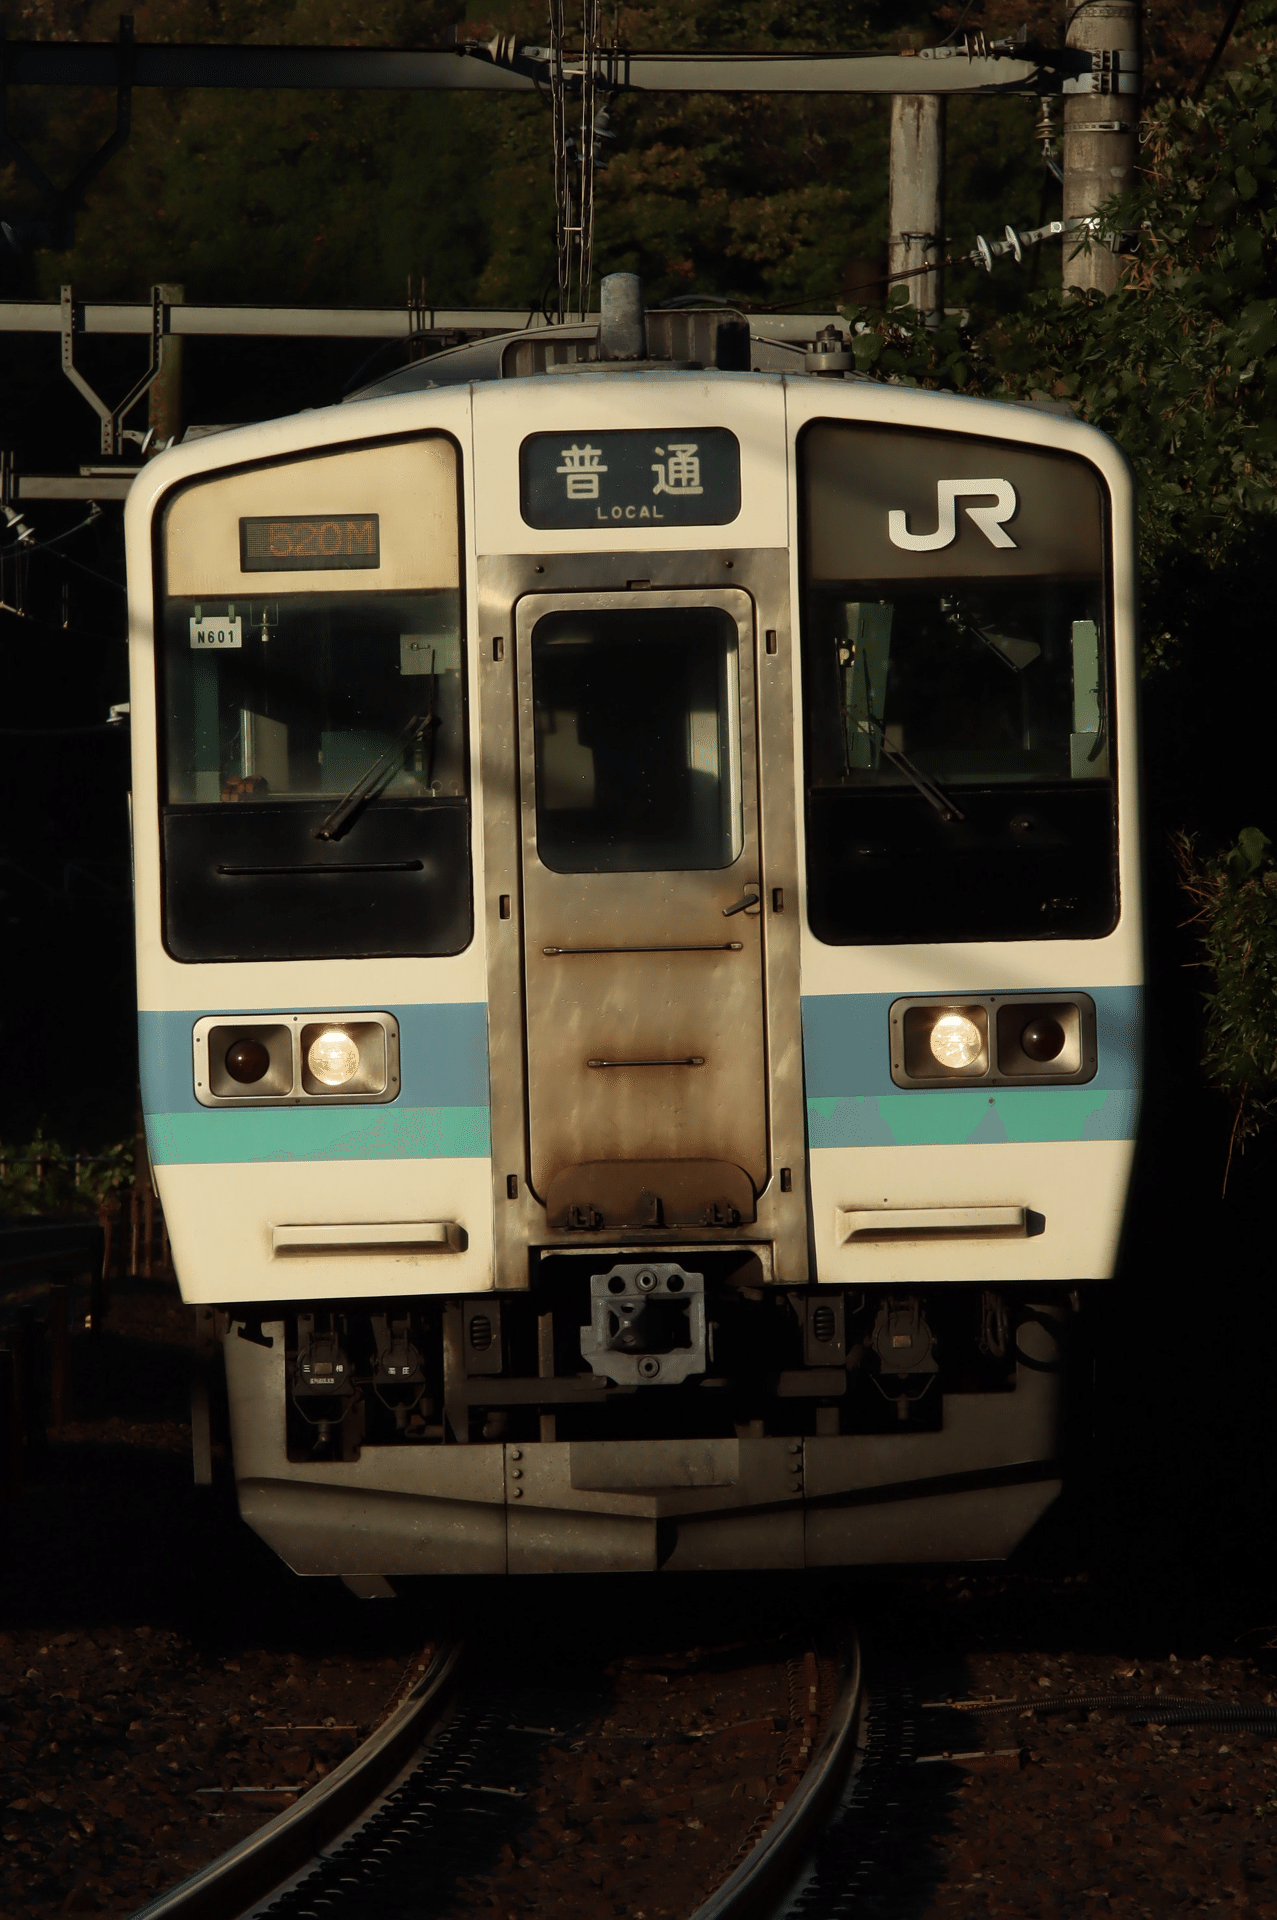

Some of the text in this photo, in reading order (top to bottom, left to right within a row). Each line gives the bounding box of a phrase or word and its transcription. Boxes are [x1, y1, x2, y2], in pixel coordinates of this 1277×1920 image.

[556, 443, 704, 499] 普通
[597, 505, 664, 520] LOCAL
[888, 478, 1018, 552] JR
[269, 520, 373, 557] 520M
[197, 629, 234, 644] N601
